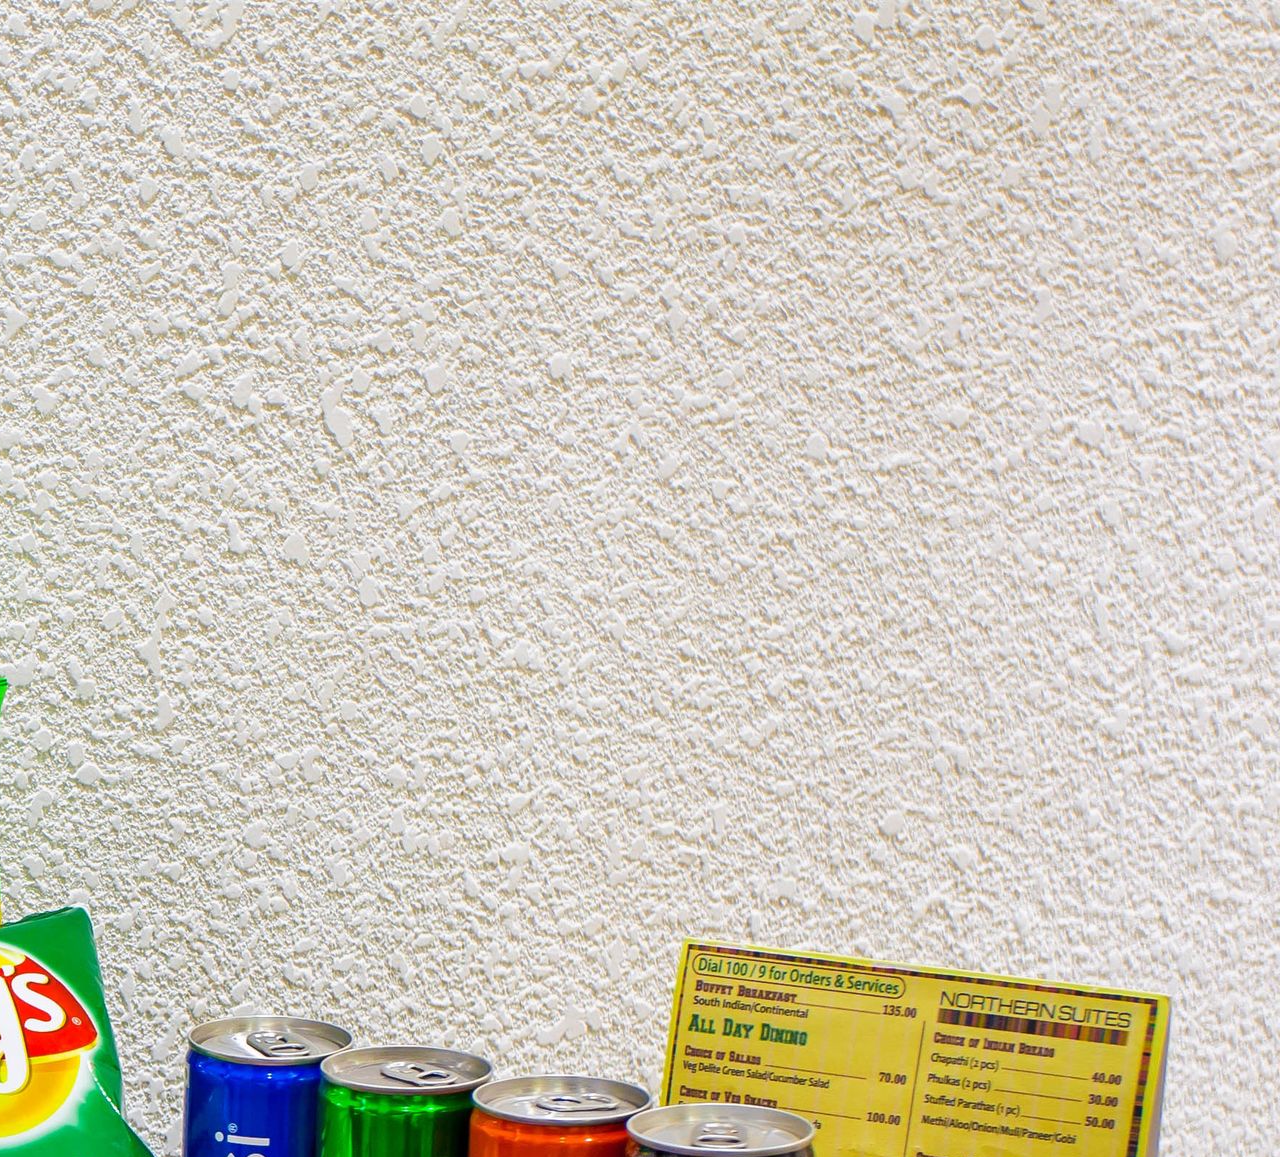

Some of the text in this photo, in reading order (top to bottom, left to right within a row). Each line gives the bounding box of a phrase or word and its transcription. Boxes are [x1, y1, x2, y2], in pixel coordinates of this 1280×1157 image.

[698, 957, 723, 973] Dial
[726, 961, 749, 976] 100
[758, 965, 767, 978] 9
[769, 966, 787, 981] for
[790, 969, 833, 987] Orders
[834, 975, 844, 988] &
[847, 976, 899, 995] Services
[693, 996, 809, 1019] South Indian/Continental
[882, 1004, 917, 1019] 135.00
[683, 1060, 830, 1088] Veg Delite Green Salad/Cucumber Salad
[878, 1071, 907, 1085] 70.00
[927, 1073, 961, 1087] Phulkas
[930, 1052, 969, 1067] Chapathi
[1091, 1071, 1123, 1086] 40.00
[866, 1112, 901, 1126] 100.00
[924, 1094, 956, 1108] Stuffed
[957, 1098, 996, 1113] Parathas
[1085, 1116, 1116, 1130] 50.00
